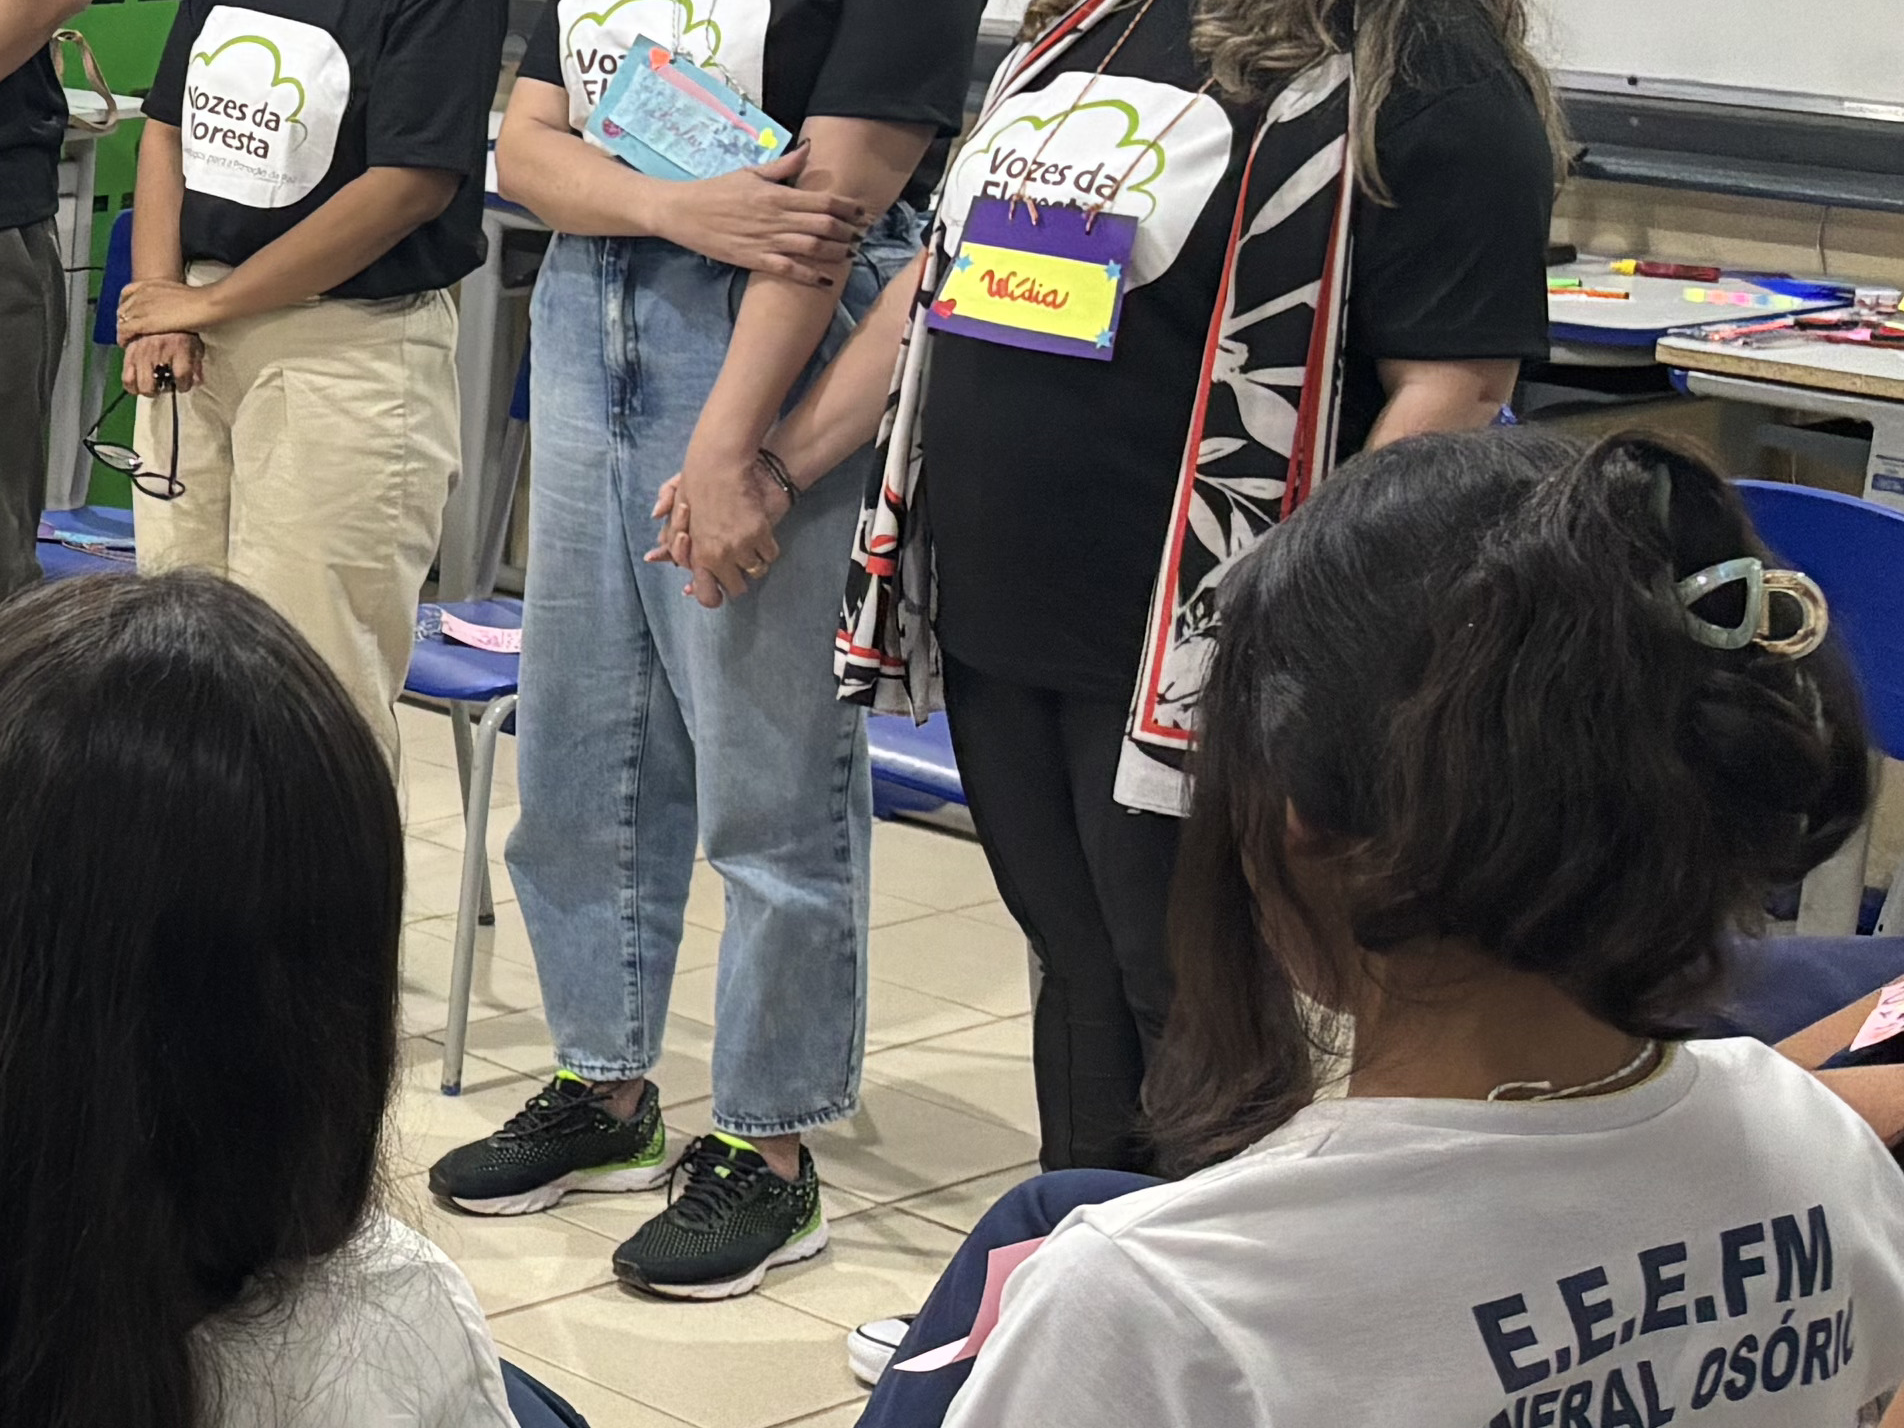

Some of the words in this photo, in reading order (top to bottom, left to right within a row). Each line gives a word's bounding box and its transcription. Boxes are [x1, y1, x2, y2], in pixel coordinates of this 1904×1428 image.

[191, 113, 269, 159] loresta
[252, 102, 281, 132] da
[990, 147, 1073, 185] Vozes
